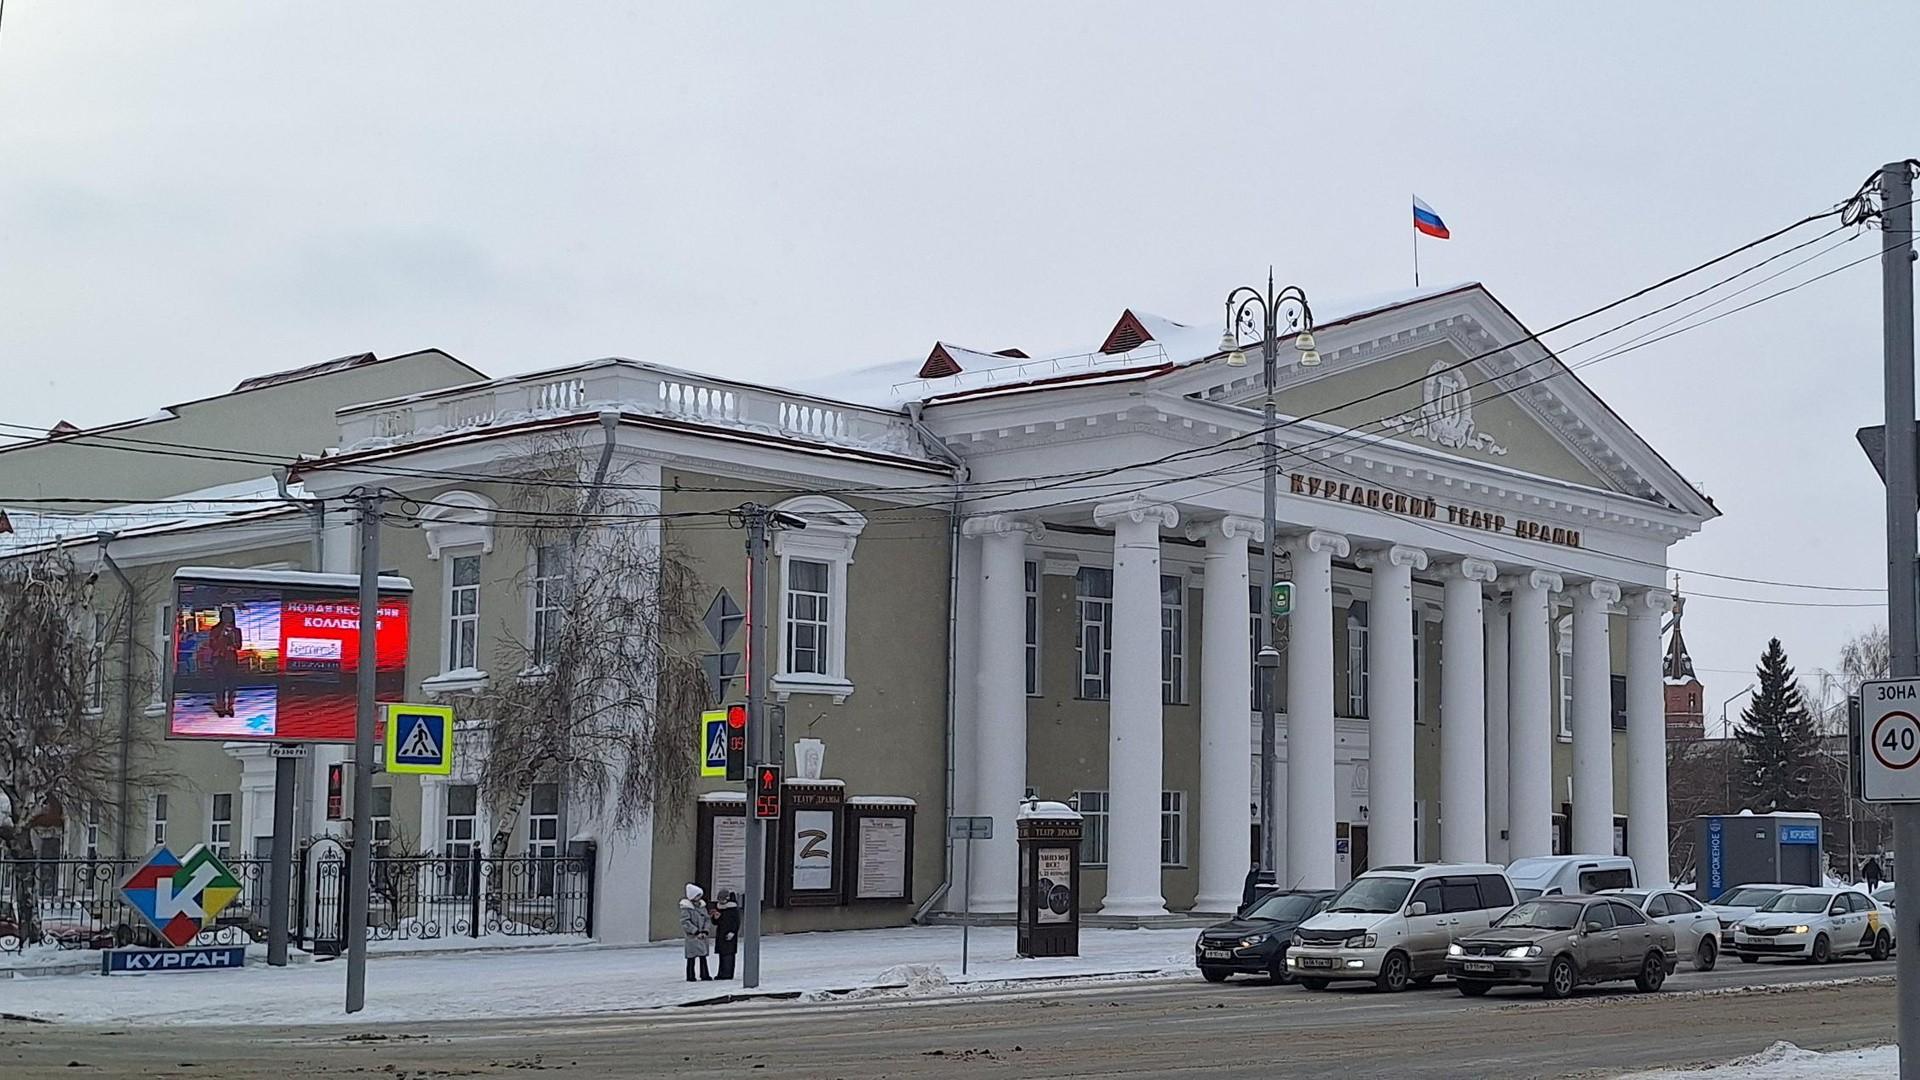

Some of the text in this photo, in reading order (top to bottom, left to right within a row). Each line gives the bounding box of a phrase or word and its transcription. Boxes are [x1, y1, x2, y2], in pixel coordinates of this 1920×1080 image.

[1290, 473, 1580, 547] КУРГАНСКИЙ ТЕАТР ДРАМЫ
[336, 604, 399, 617] ВЕСНЯЯ
[1878, 685, 1917, 701] ЗОНА
[1882, 727, 1914, 751] 40
[758, 796, 777, 815] 55
[1711, 833, 1721, 889] МОРОЖЕНОЕ
[126, 952, 230, 969] КУРГАН
